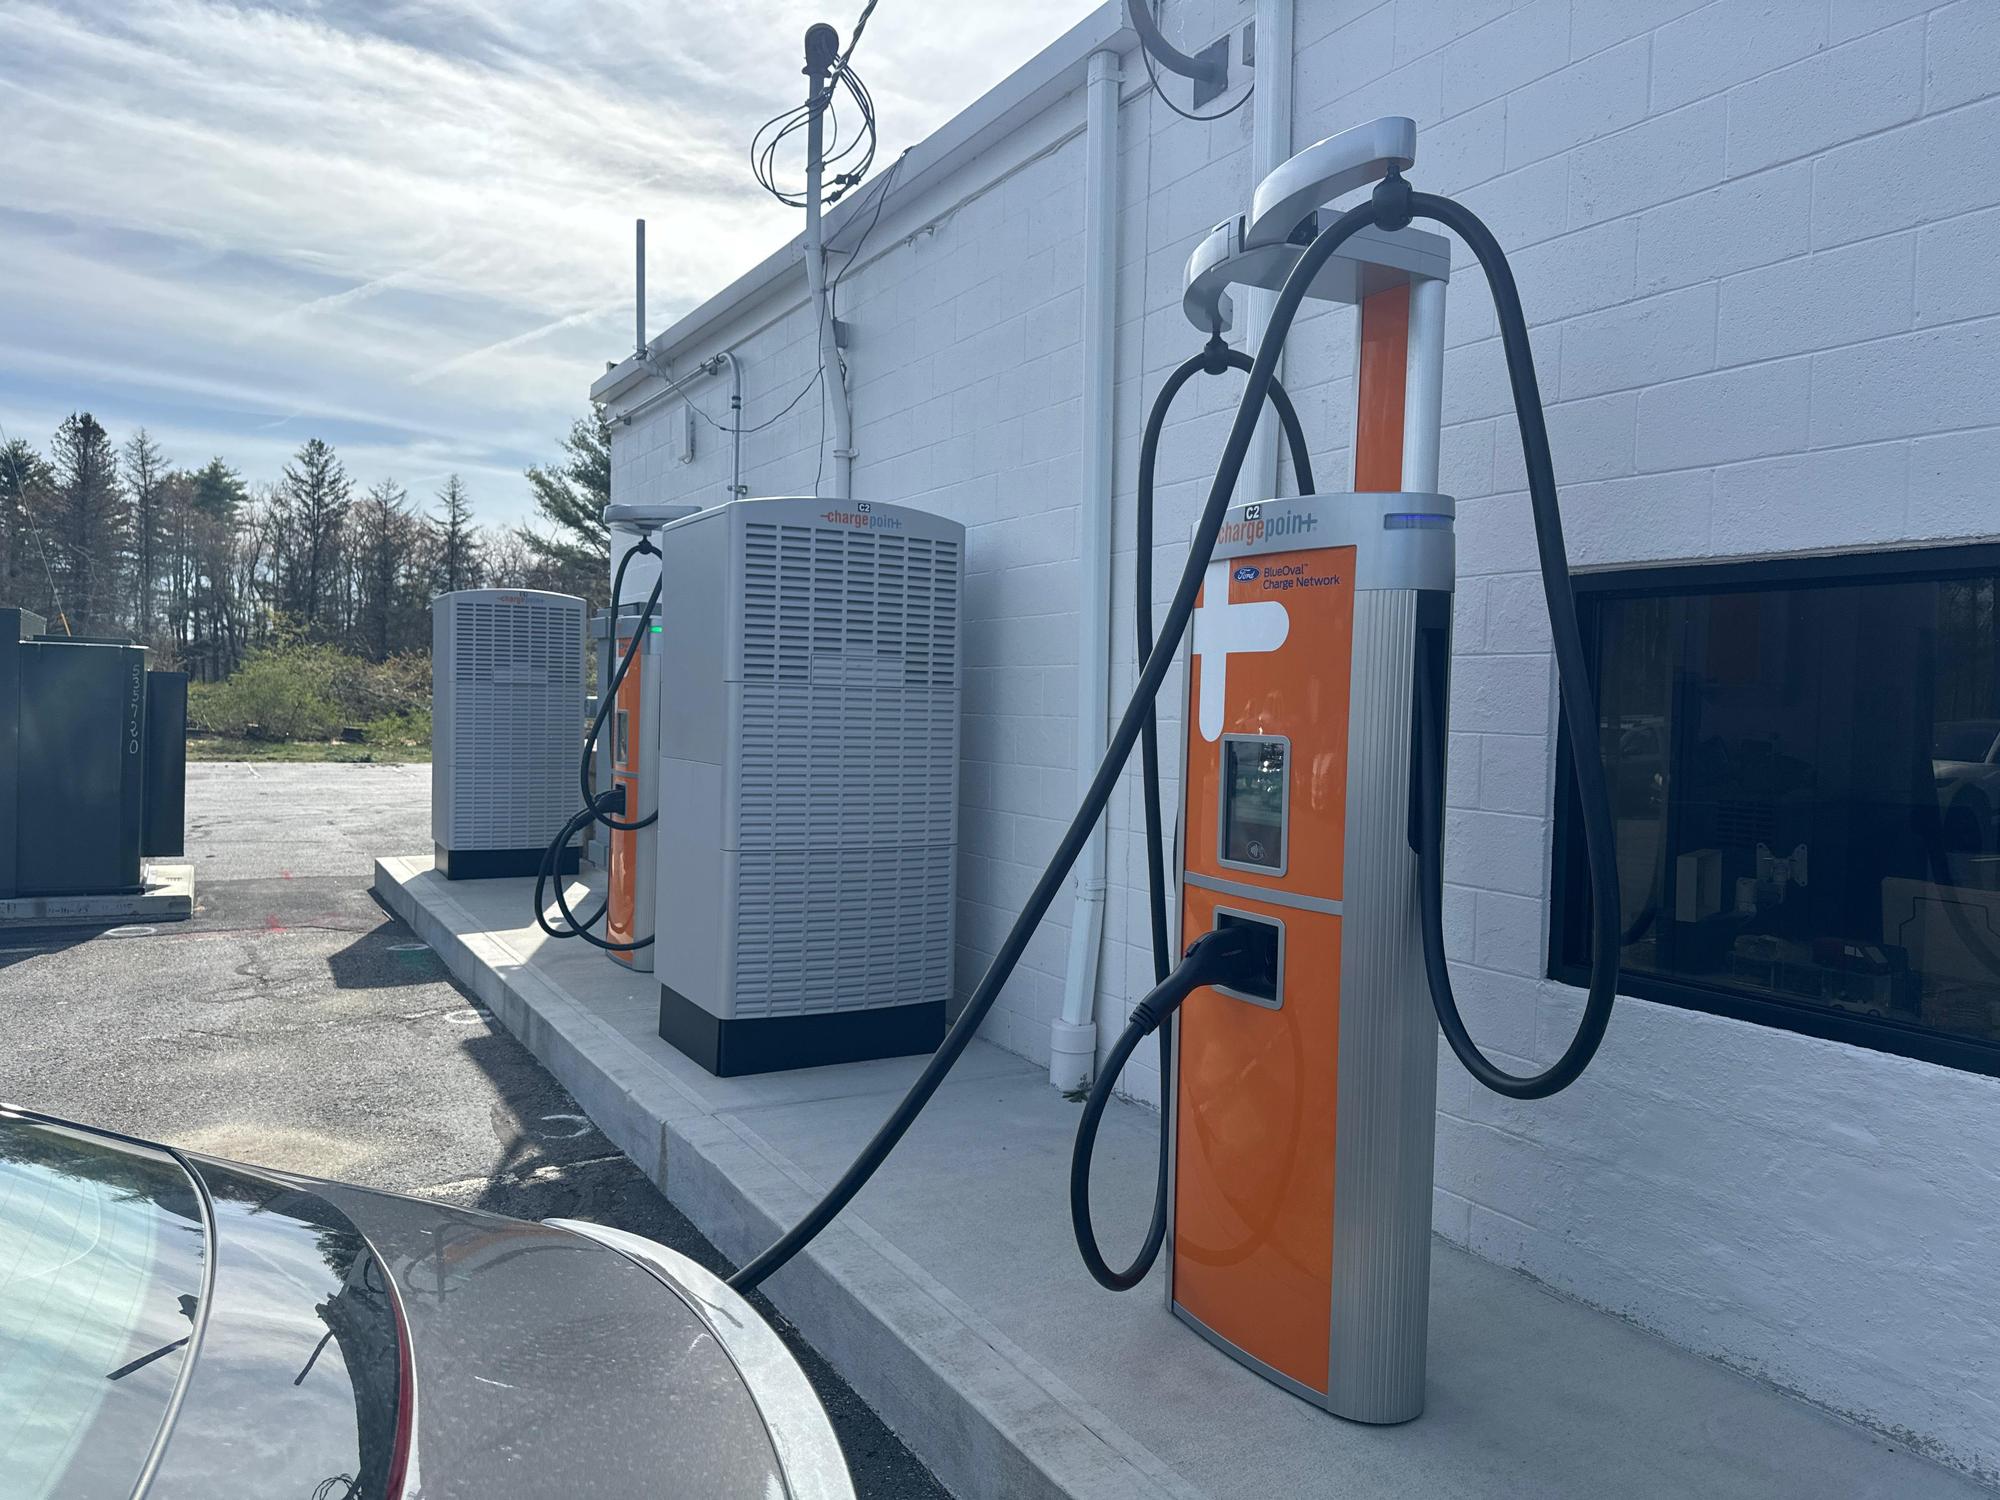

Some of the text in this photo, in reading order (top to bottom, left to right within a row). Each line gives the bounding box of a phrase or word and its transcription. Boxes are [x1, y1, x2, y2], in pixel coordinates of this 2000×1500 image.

[859, 504, 870, 512] C2
[1246, 506, 1260, 519] C2
[1263, 574, 1340, 590] Charge Network
